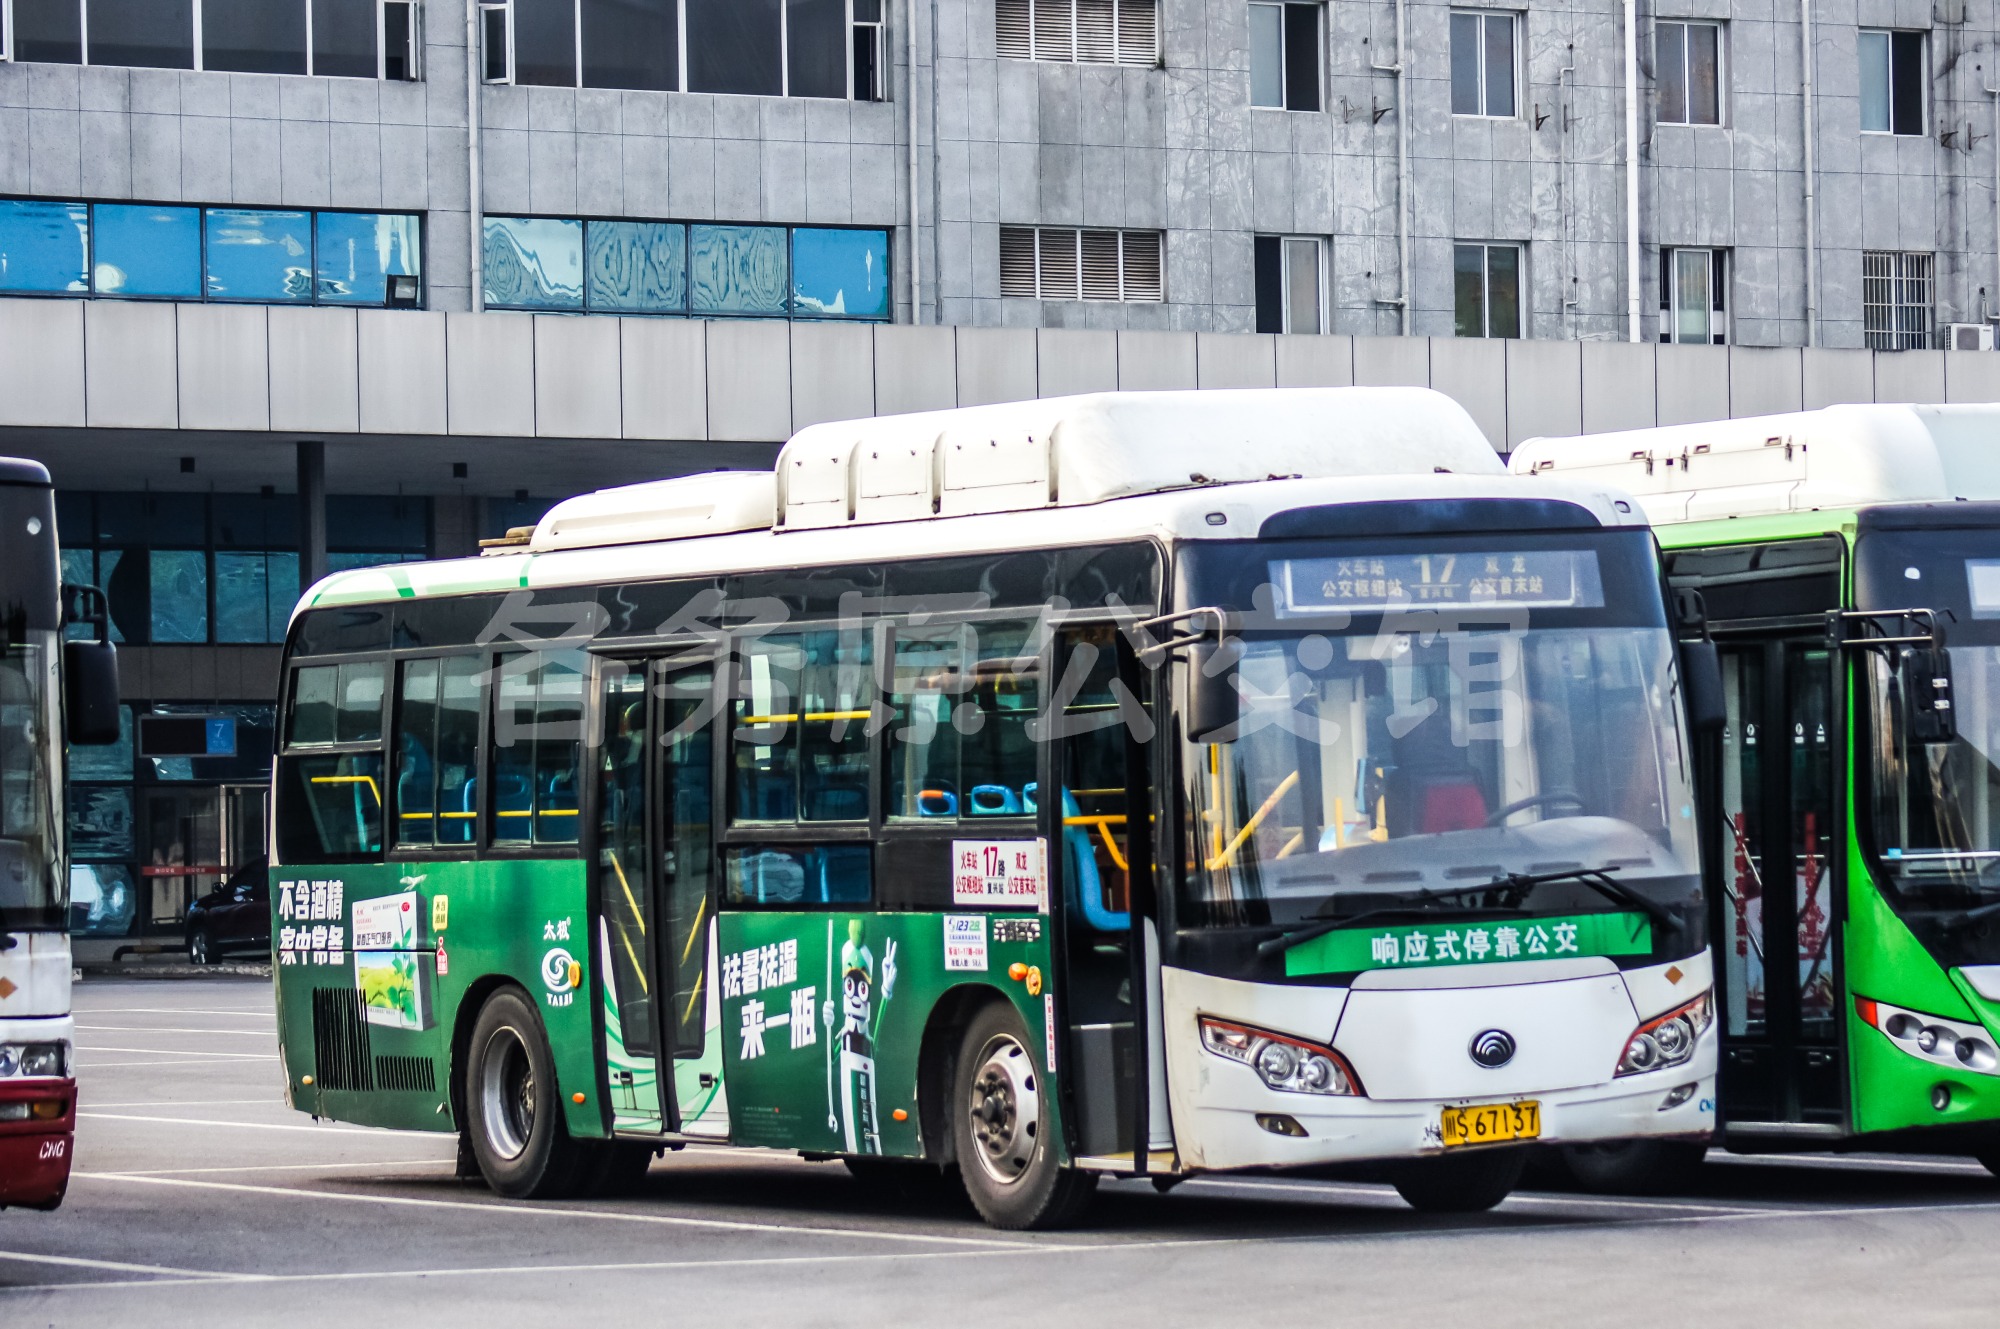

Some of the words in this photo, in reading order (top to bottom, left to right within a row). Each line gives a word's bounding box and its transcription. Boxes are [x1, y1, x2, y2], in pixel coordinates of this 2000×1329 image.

[1413, 554, 1456, 584] 17
[960, 850, 978, 870] 火车站
[278, 880, 344, 921] 不含酒精
[279, 925, 345, 966] 家中常备
[1371, 921, 1579, 965] 响应式停靠公交
[722, 938, 798, 999] 祛暑祛湿
[740, 985, 817, 1061] 来一瓶
[39, 1140, 65, 1159] CNG
